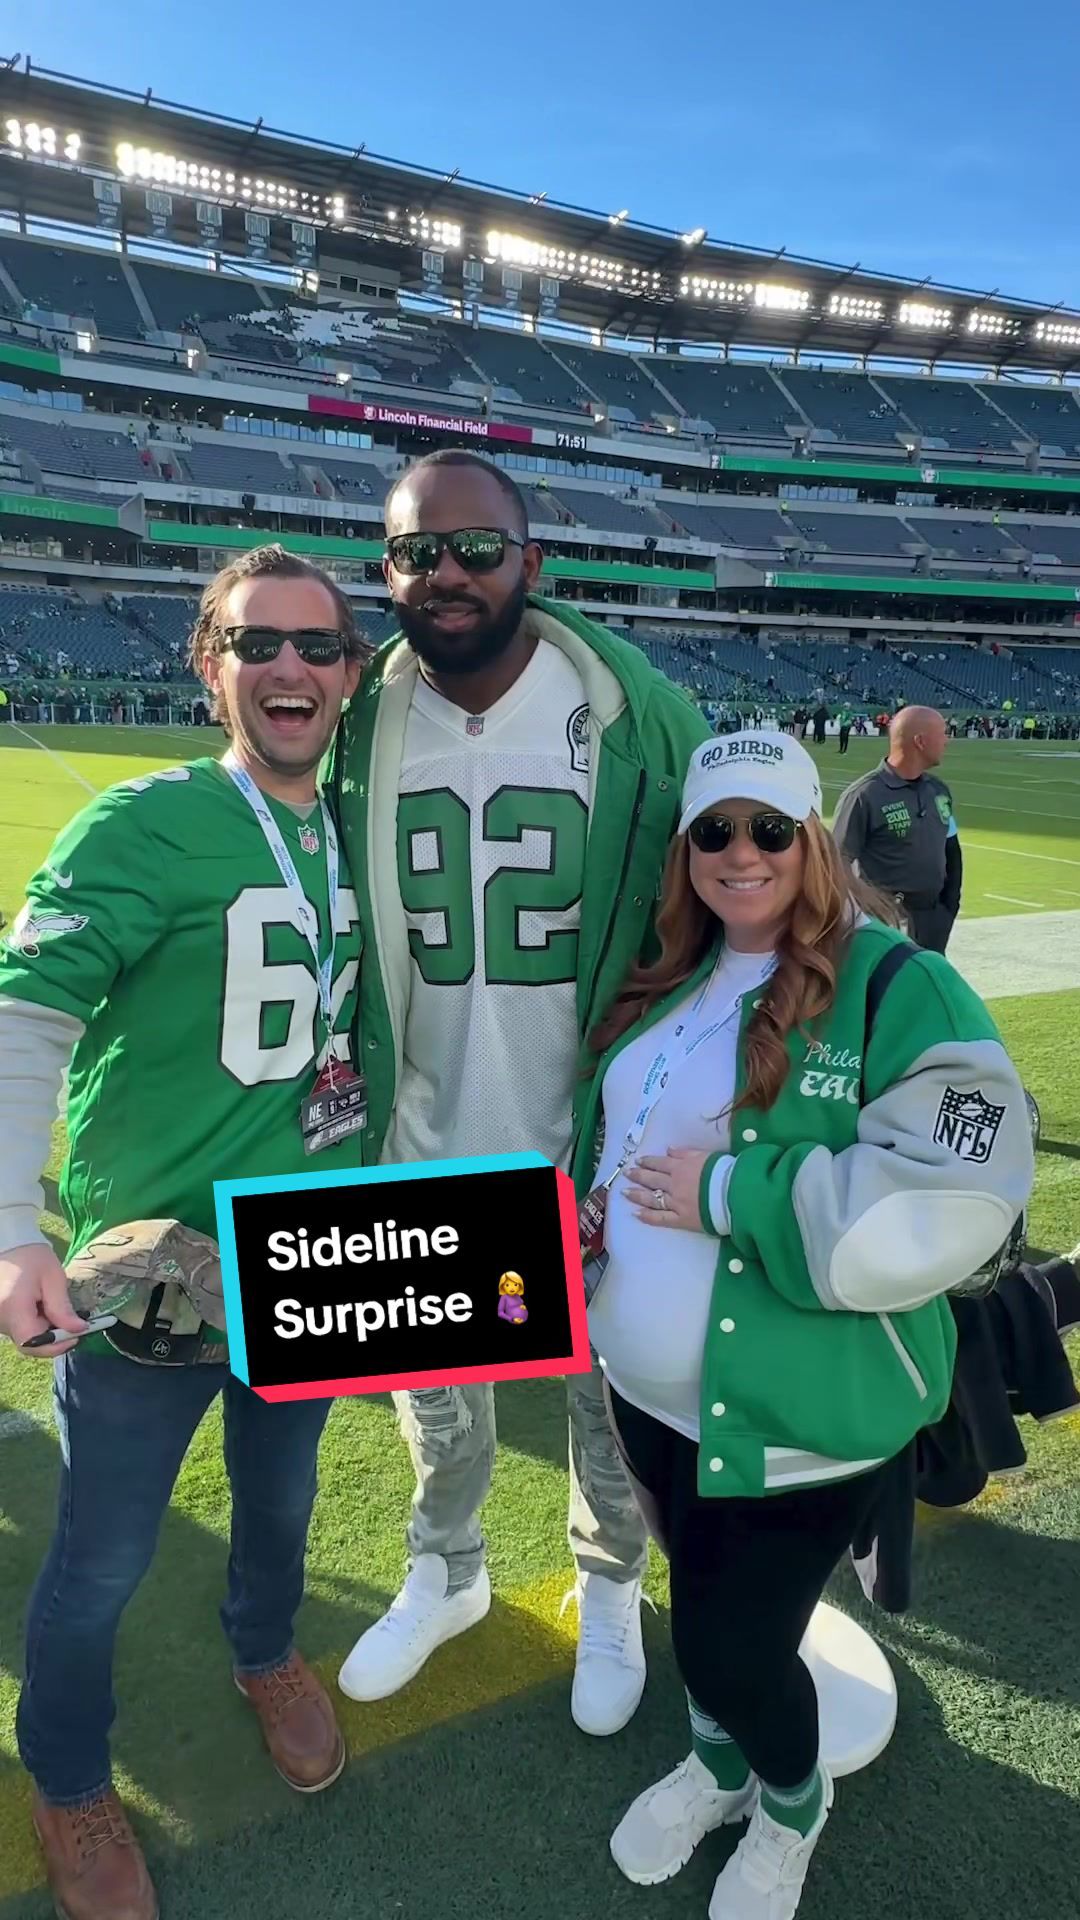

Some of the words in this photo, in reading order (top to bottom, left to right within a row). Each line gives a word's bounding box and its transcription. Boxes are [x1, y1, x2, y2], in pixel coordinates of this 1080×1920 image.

[379, 408, 417, 425] Lincoln
[418, 414, 463, 433] Financial
[464, 421, 488, 436] Field
[557, 433, 586, 449] 71:51
[700, 746, 723, 768] GO
[727, 740, 784, 761] BIRDS
[707, 756, 751, 772] Philadelphia
[396, 784, 589, 987] 92
[217, 884, 363, 1089] 62
[308, 1101, 323, 1122] NE
[328, 1114, 364, 1139] EAGLES
[937, 1113, 987, 1158] NFL
